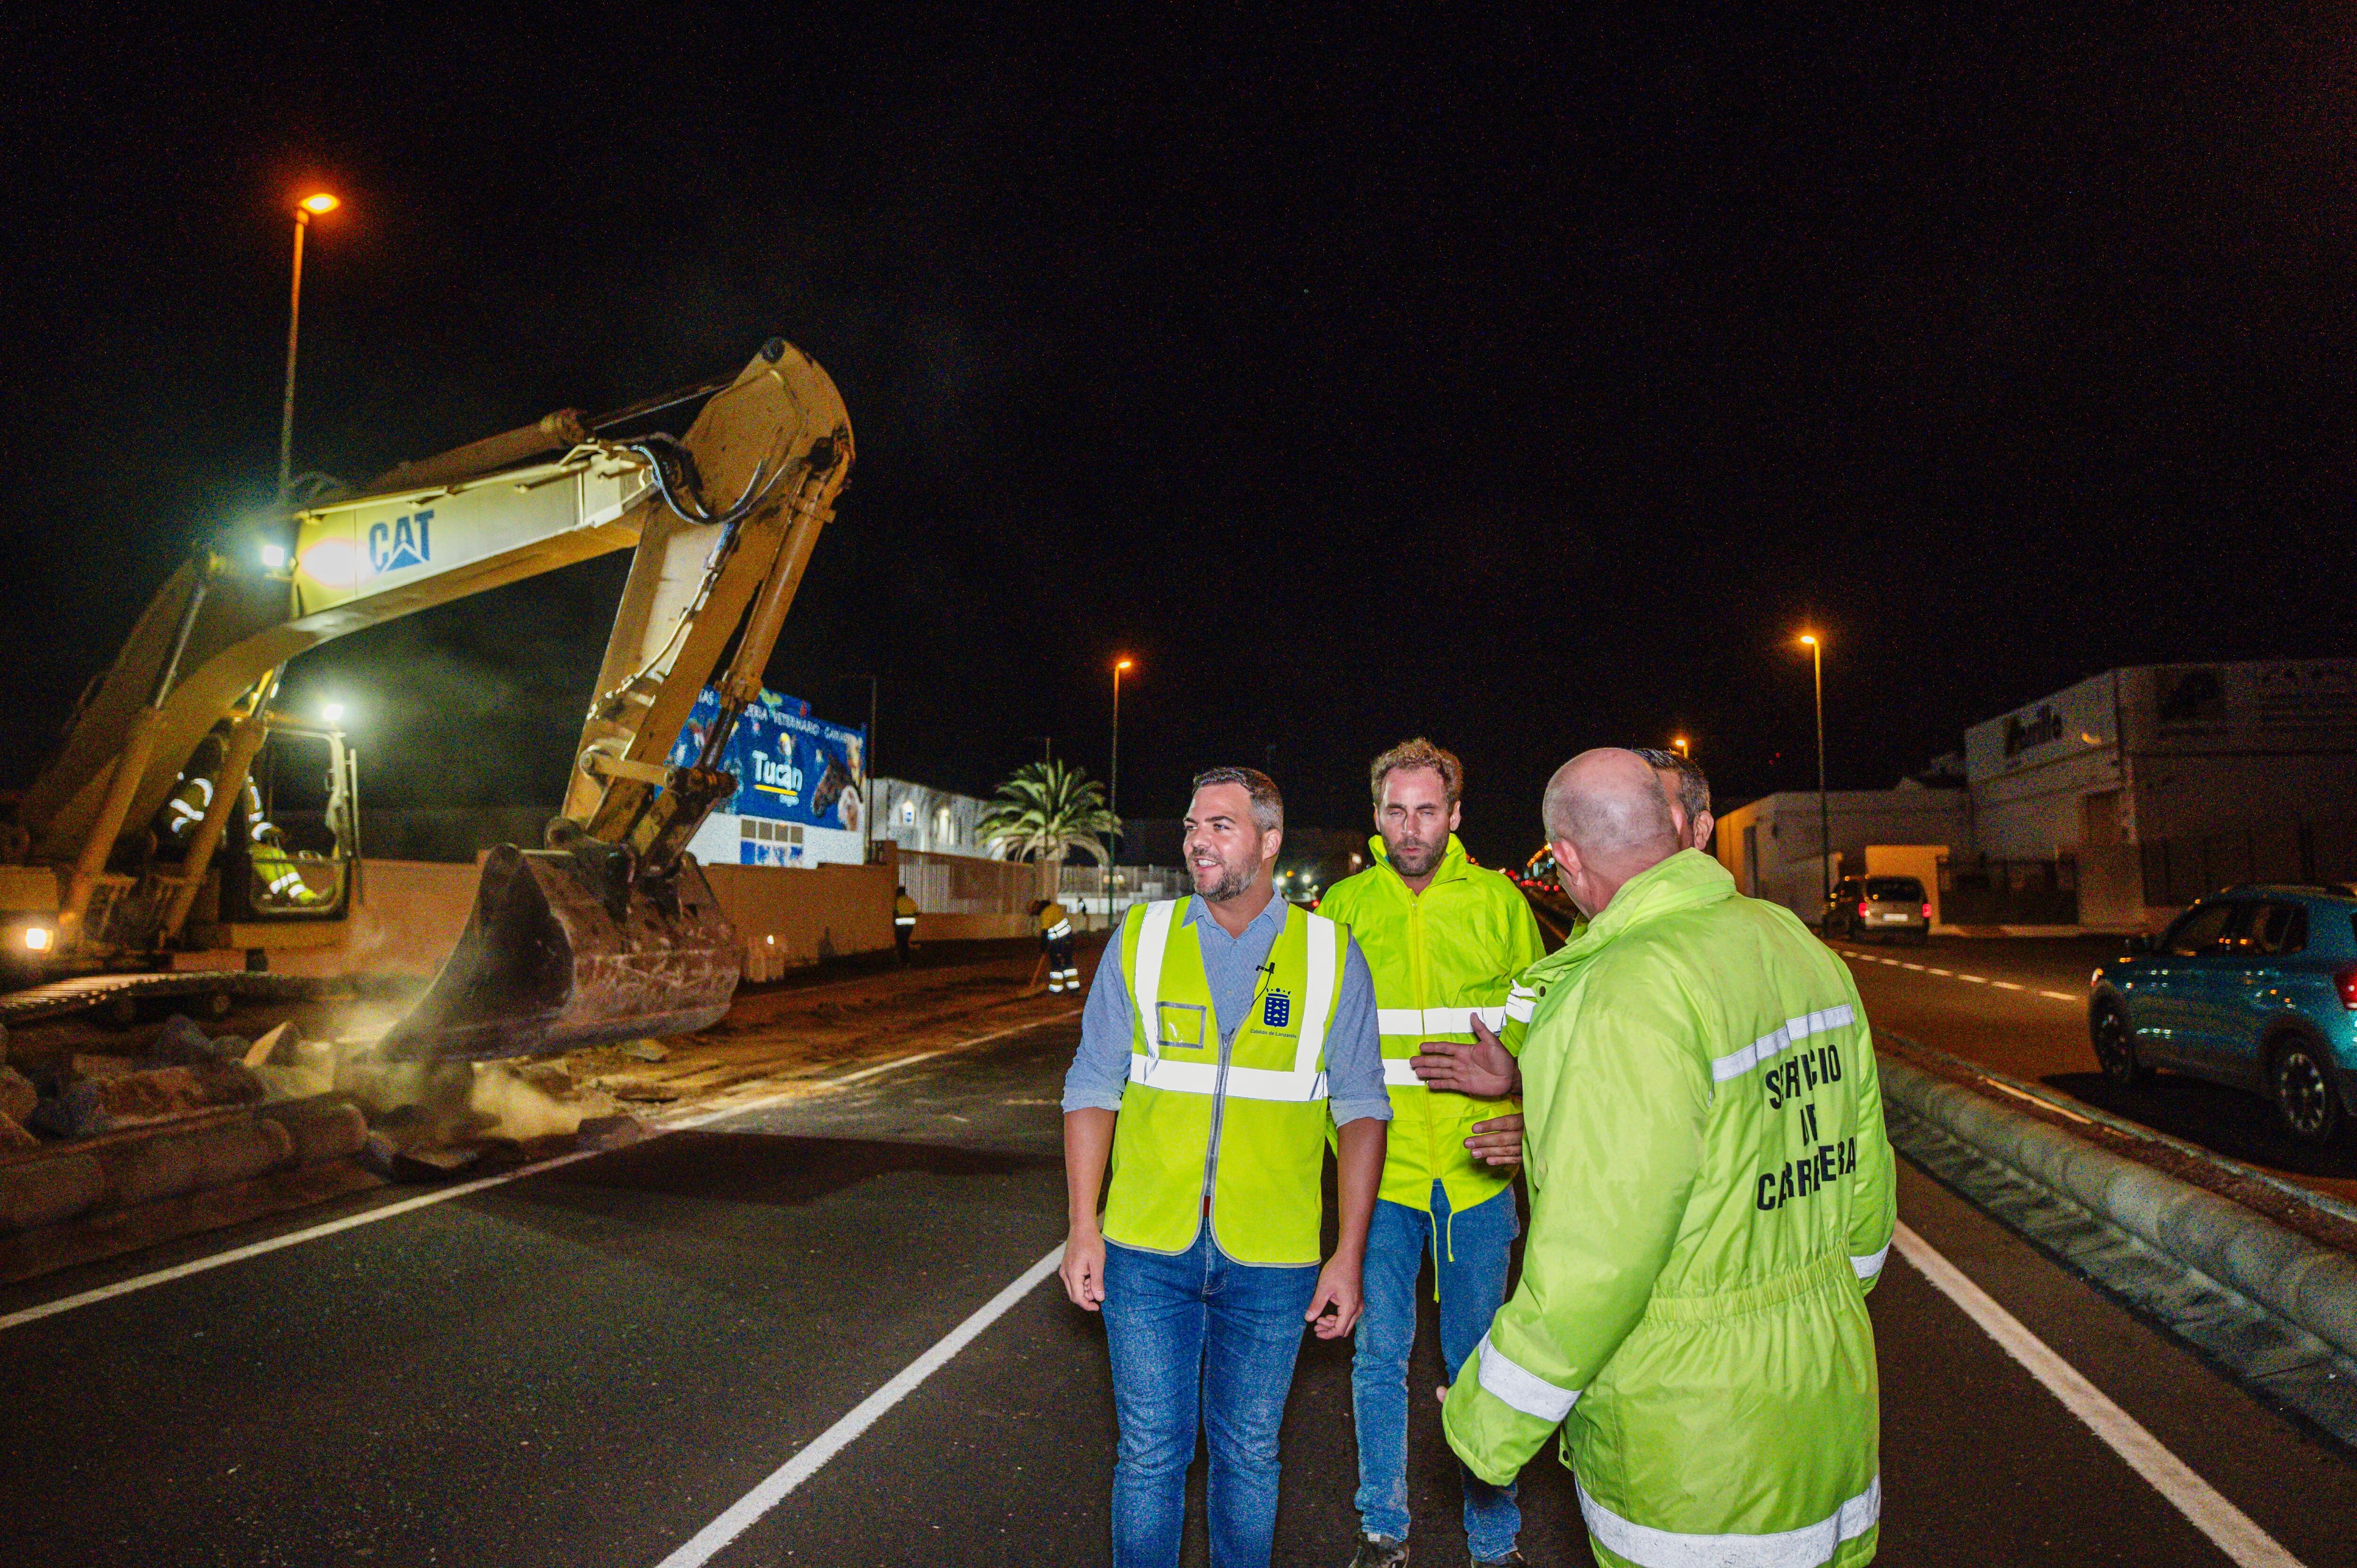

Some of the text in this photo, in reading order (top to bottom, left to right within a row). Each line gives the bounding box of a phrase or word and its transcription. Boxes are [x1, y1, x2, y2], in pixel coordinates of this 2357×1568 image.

[369, 509, 434, 575] CAT
[752, 750, 803, 792] Tucan
[1765, 1044, 1841, 1110] SRVCIO
[1756, 1137, 1856, 1211] CARREERA
